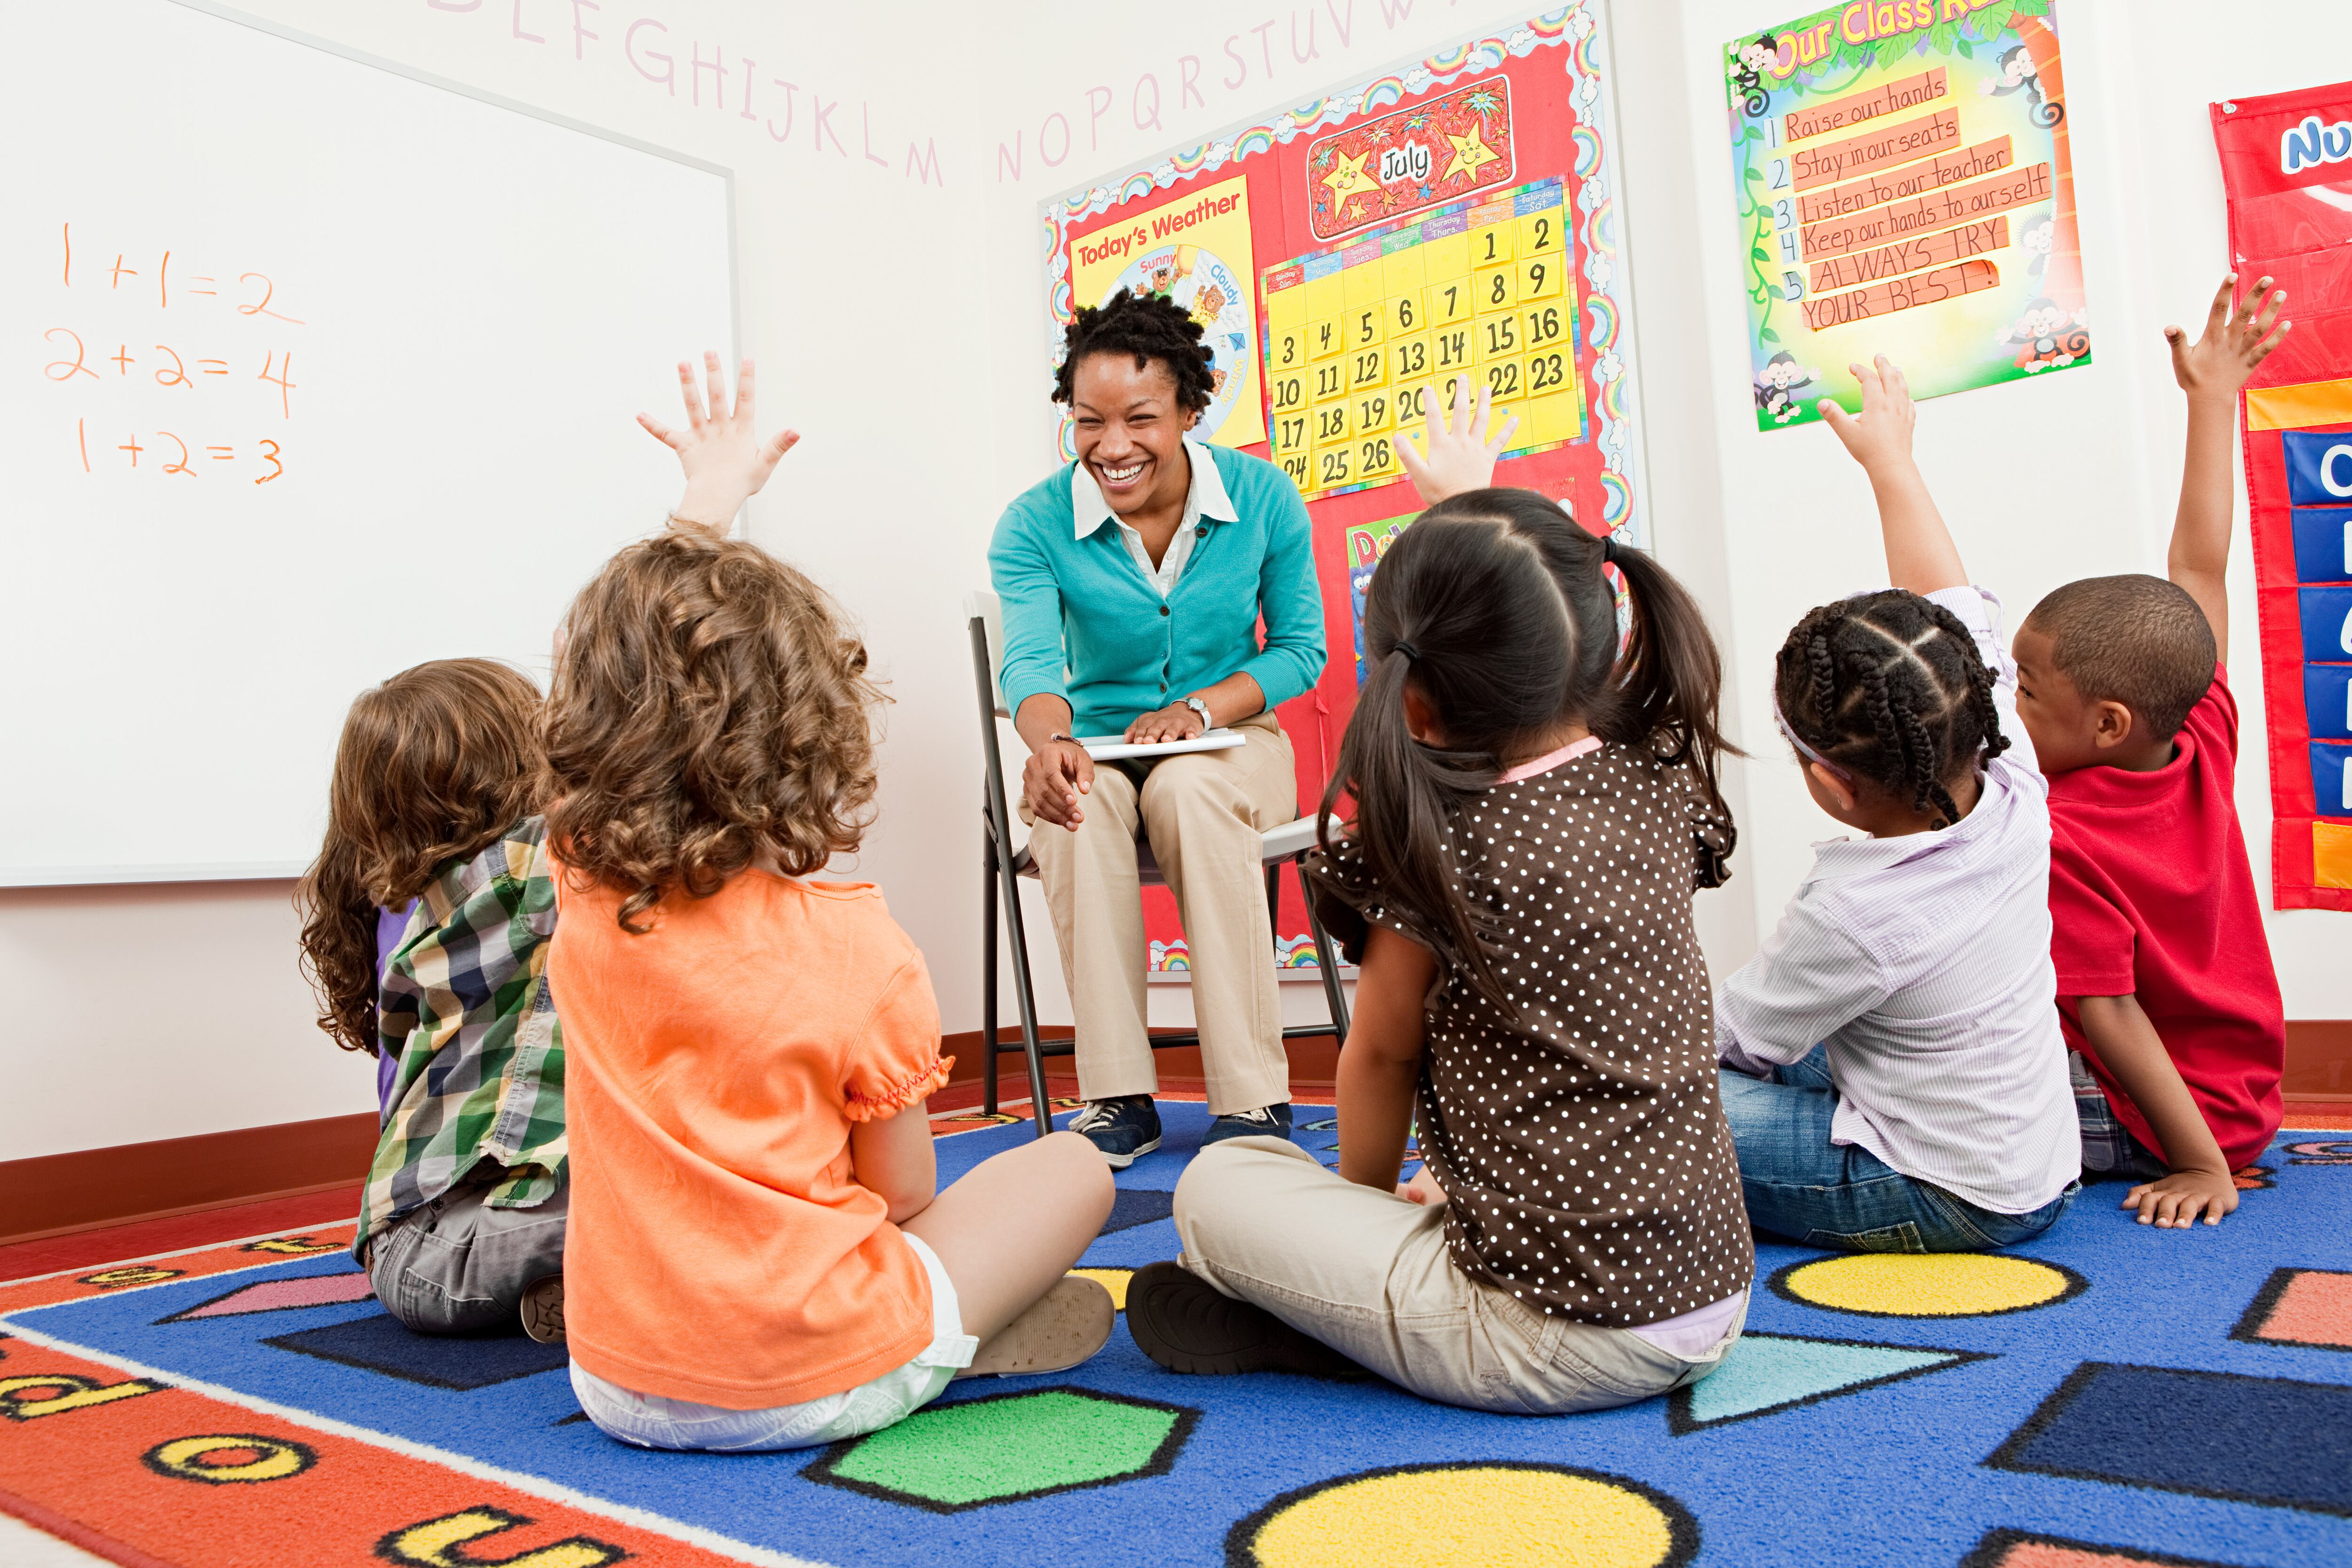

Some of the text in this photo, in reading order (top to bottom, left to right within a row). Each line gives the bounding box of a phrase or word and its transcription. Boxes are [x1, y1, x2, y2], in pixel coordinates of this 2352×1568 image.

[1771, 21, 1835, 78] Our
[1841, 0, 1934, 44] Class
[1786, 112, 1843, 141] Raise
[1851, 100, 1882, 122] our
[1886, 71, 1946, 112] hands
[1384, 149, 1428, 180] July
[1772, 159, 1788, 189] 2
[1795, 148, 1843, 181] Stay
[1868, 139, 1895, 159] our
[1899, 113, 1957, 152] seats
[1777, 147, 2004, 230] 3 Listen to our teacher
[1078, 193, 1241, 267] Today's Weather
[1276, 189, 1555, 281] Sunday Monday Tuesday Wednesday Thursday Friday Saturday
[1485, 219, 1549, 260] 1 2
[1781, 232, 1796, 260] 4
[1802, 224, 1853, 255] Keep
[1860, 222, 1884, 242] our
[1888, 197, 1937, 235] hands
[1944, 190, 1963, 218] to
[1815, 237, 1932, 292] ALWAYS
[1943, 218, 1997, 259] TRY
[1140, 254, 1176, 273] Sunny
[1210, 264, 1238, 306] Cloudy
[1283, 264, 1544, 363] 3 4 5 6 7 8 9
[1802, 290, 1870, 332] YOUR
[1221, 358, 1246, 406] Windy
[1276, 309, 1558, 407] 10 11 12 13 14 15 16
[1283, 418, 1303, 448] 17
[1320, 409, 1343, 438] 18
[1362, 400, 1384, 429] 19
[1489, 364, 1518, 398] 22
[1532, 354, 1562, 390] 23
[1324, 450, 1348, 483] 25
[1363, 439, 1389, 472] 26
